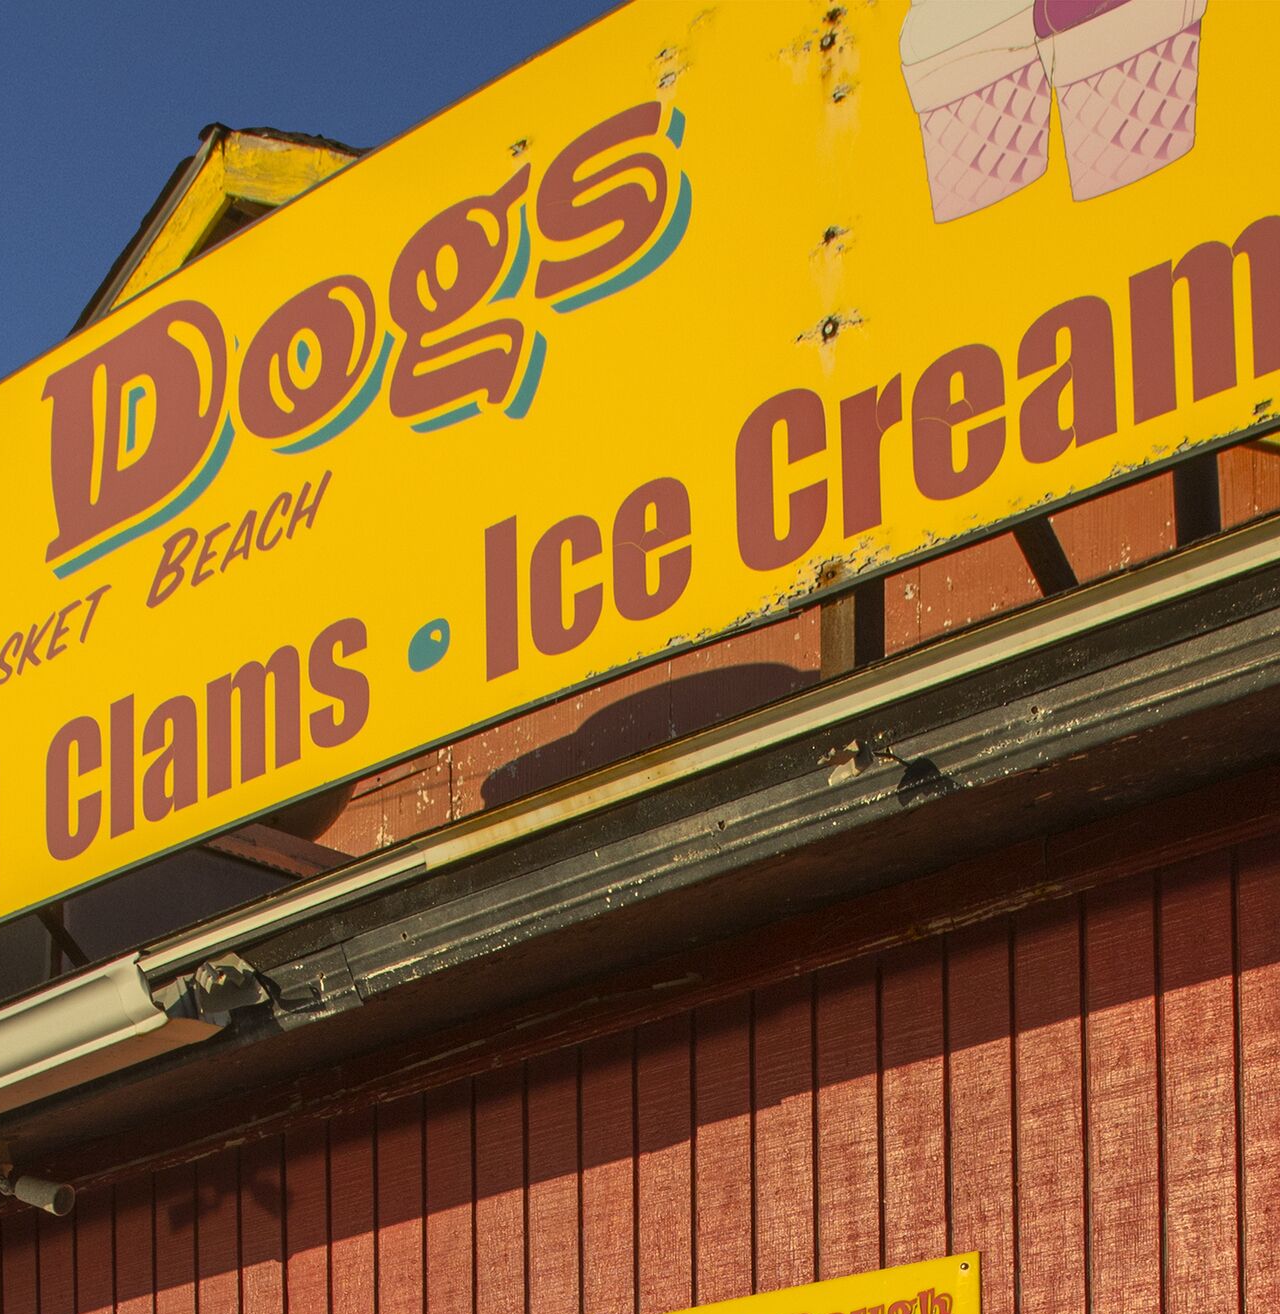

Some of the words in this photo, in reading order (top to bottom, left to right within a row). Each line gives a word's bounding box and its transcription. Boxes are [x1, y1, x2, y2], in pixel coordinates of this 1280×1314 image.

[42, 101, 690, 574] Dogs
[46, 617, 370, 862] Clams
[485, 477, 693, 683] Ice
[146, 470, 334, 609] BEACH
